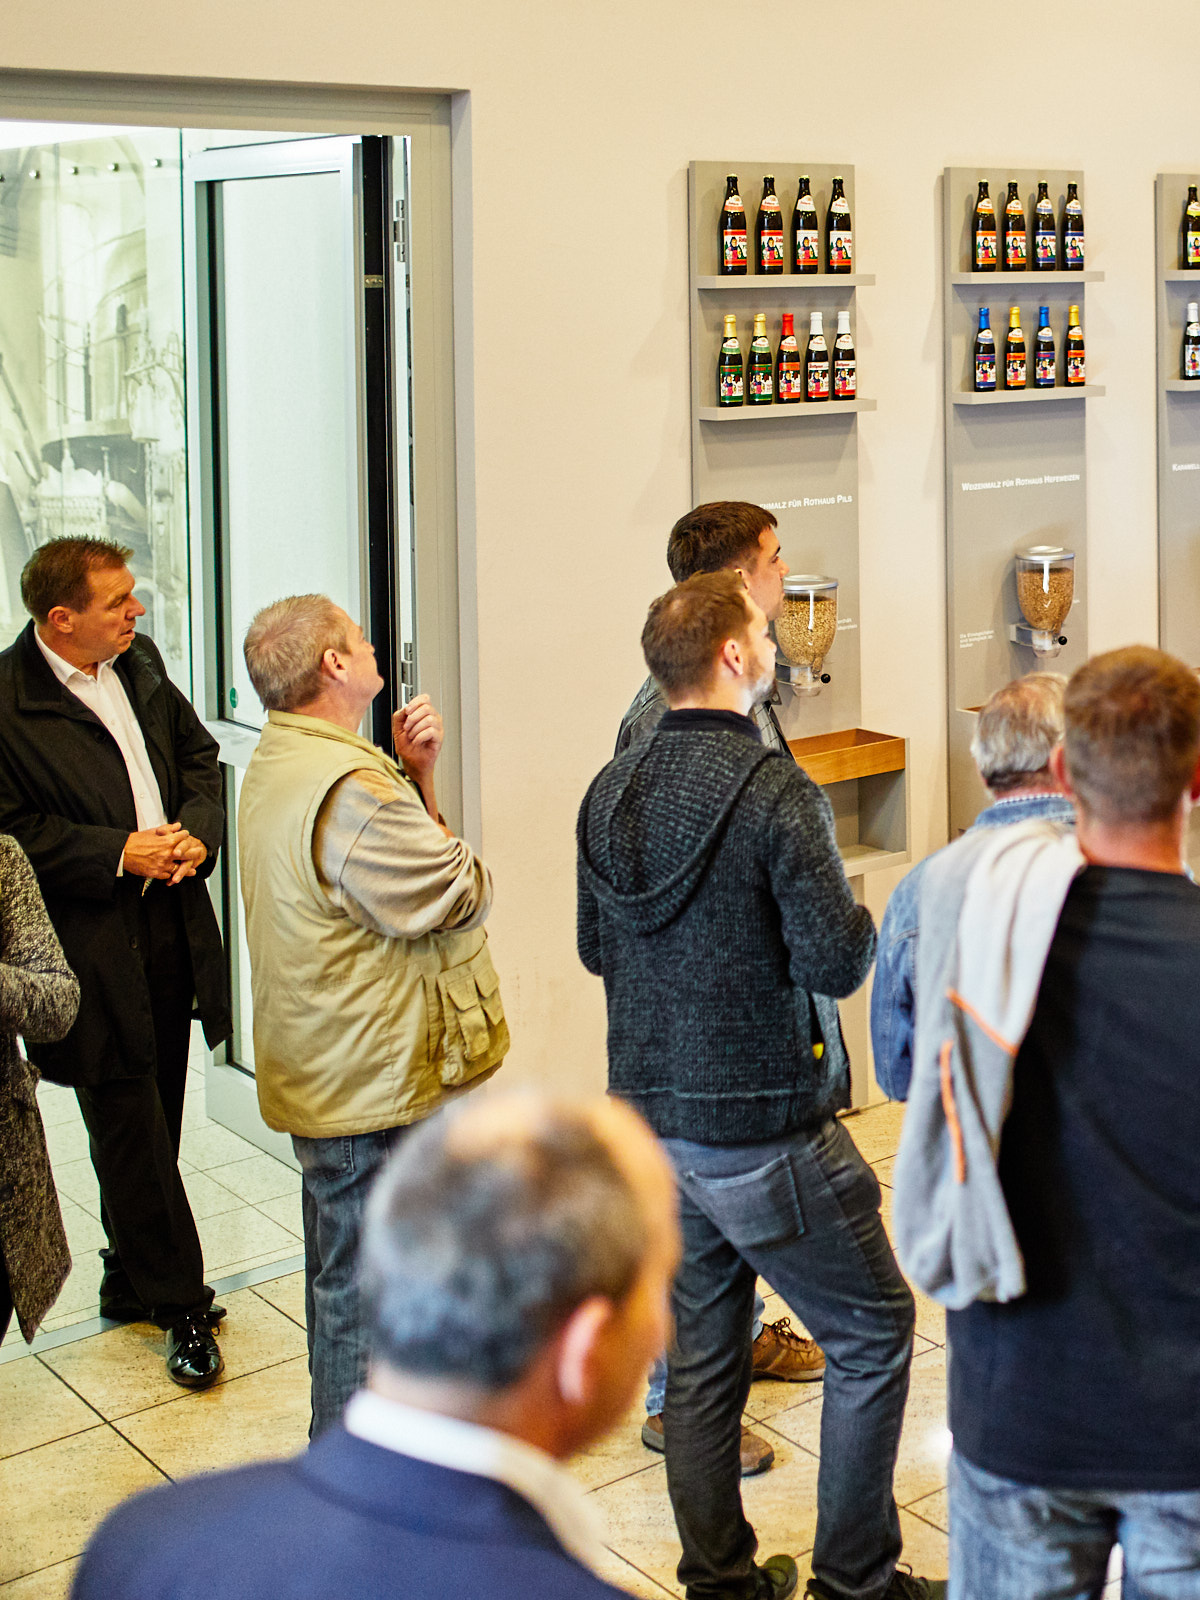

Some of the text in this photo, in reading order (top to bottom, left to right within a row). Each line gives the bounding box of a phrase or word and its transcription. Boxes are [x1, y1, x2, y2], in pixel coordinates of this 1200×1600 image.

[759, 501, 787, 510] ENMALZ
[803, 497, 836, 507] ROTHAUS
[836, 494, 853, 504] PILS
